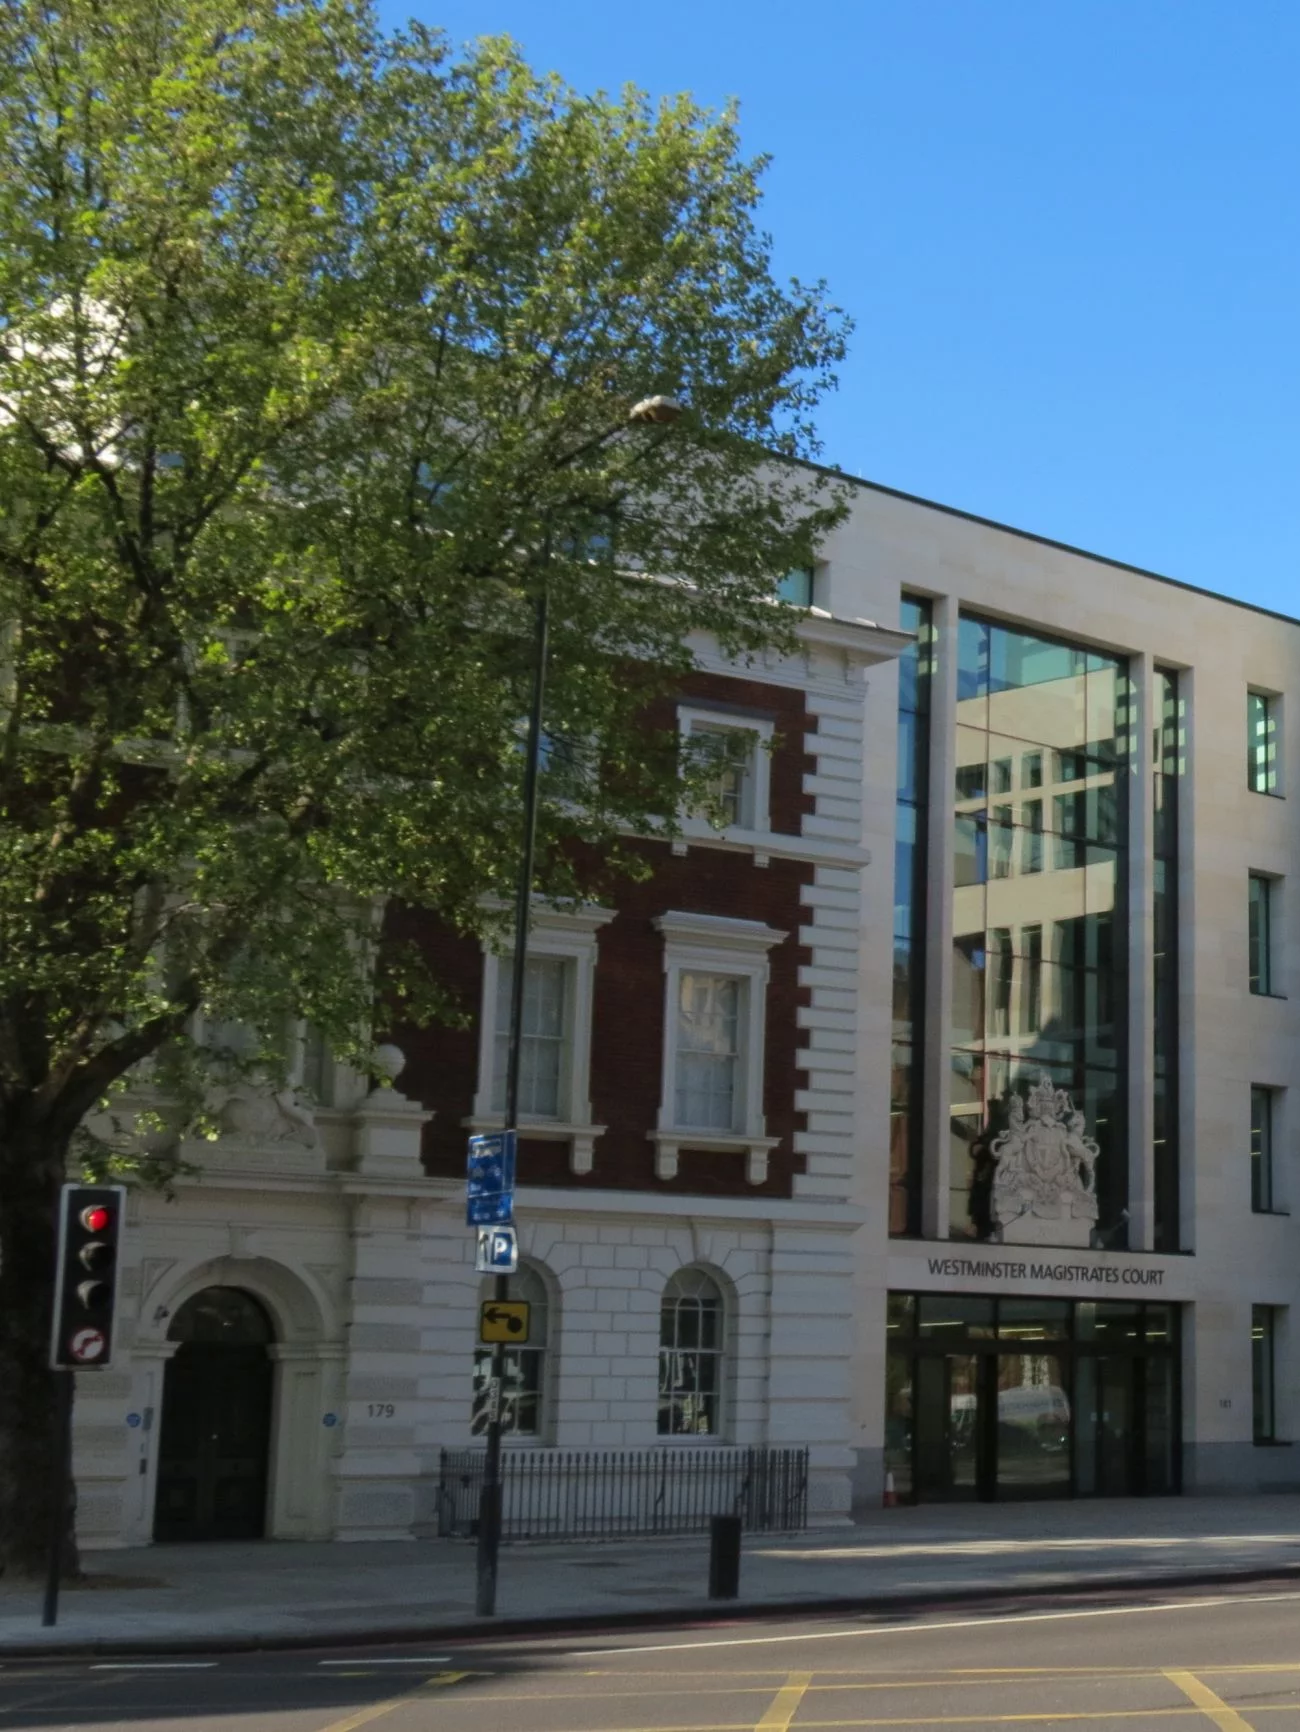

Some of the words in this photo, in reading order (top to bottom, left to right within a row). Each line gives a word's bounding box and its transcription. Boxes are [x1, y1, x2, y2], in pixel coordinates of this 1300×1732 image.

[927, 1258, 1026, 1279] WESTMINSTER
[1030, 1264, 1119, 1284] MAGISTRATES
[1122, 1268, 1165, 1285] COURT
[368, 1404, 395, 1418] 179
